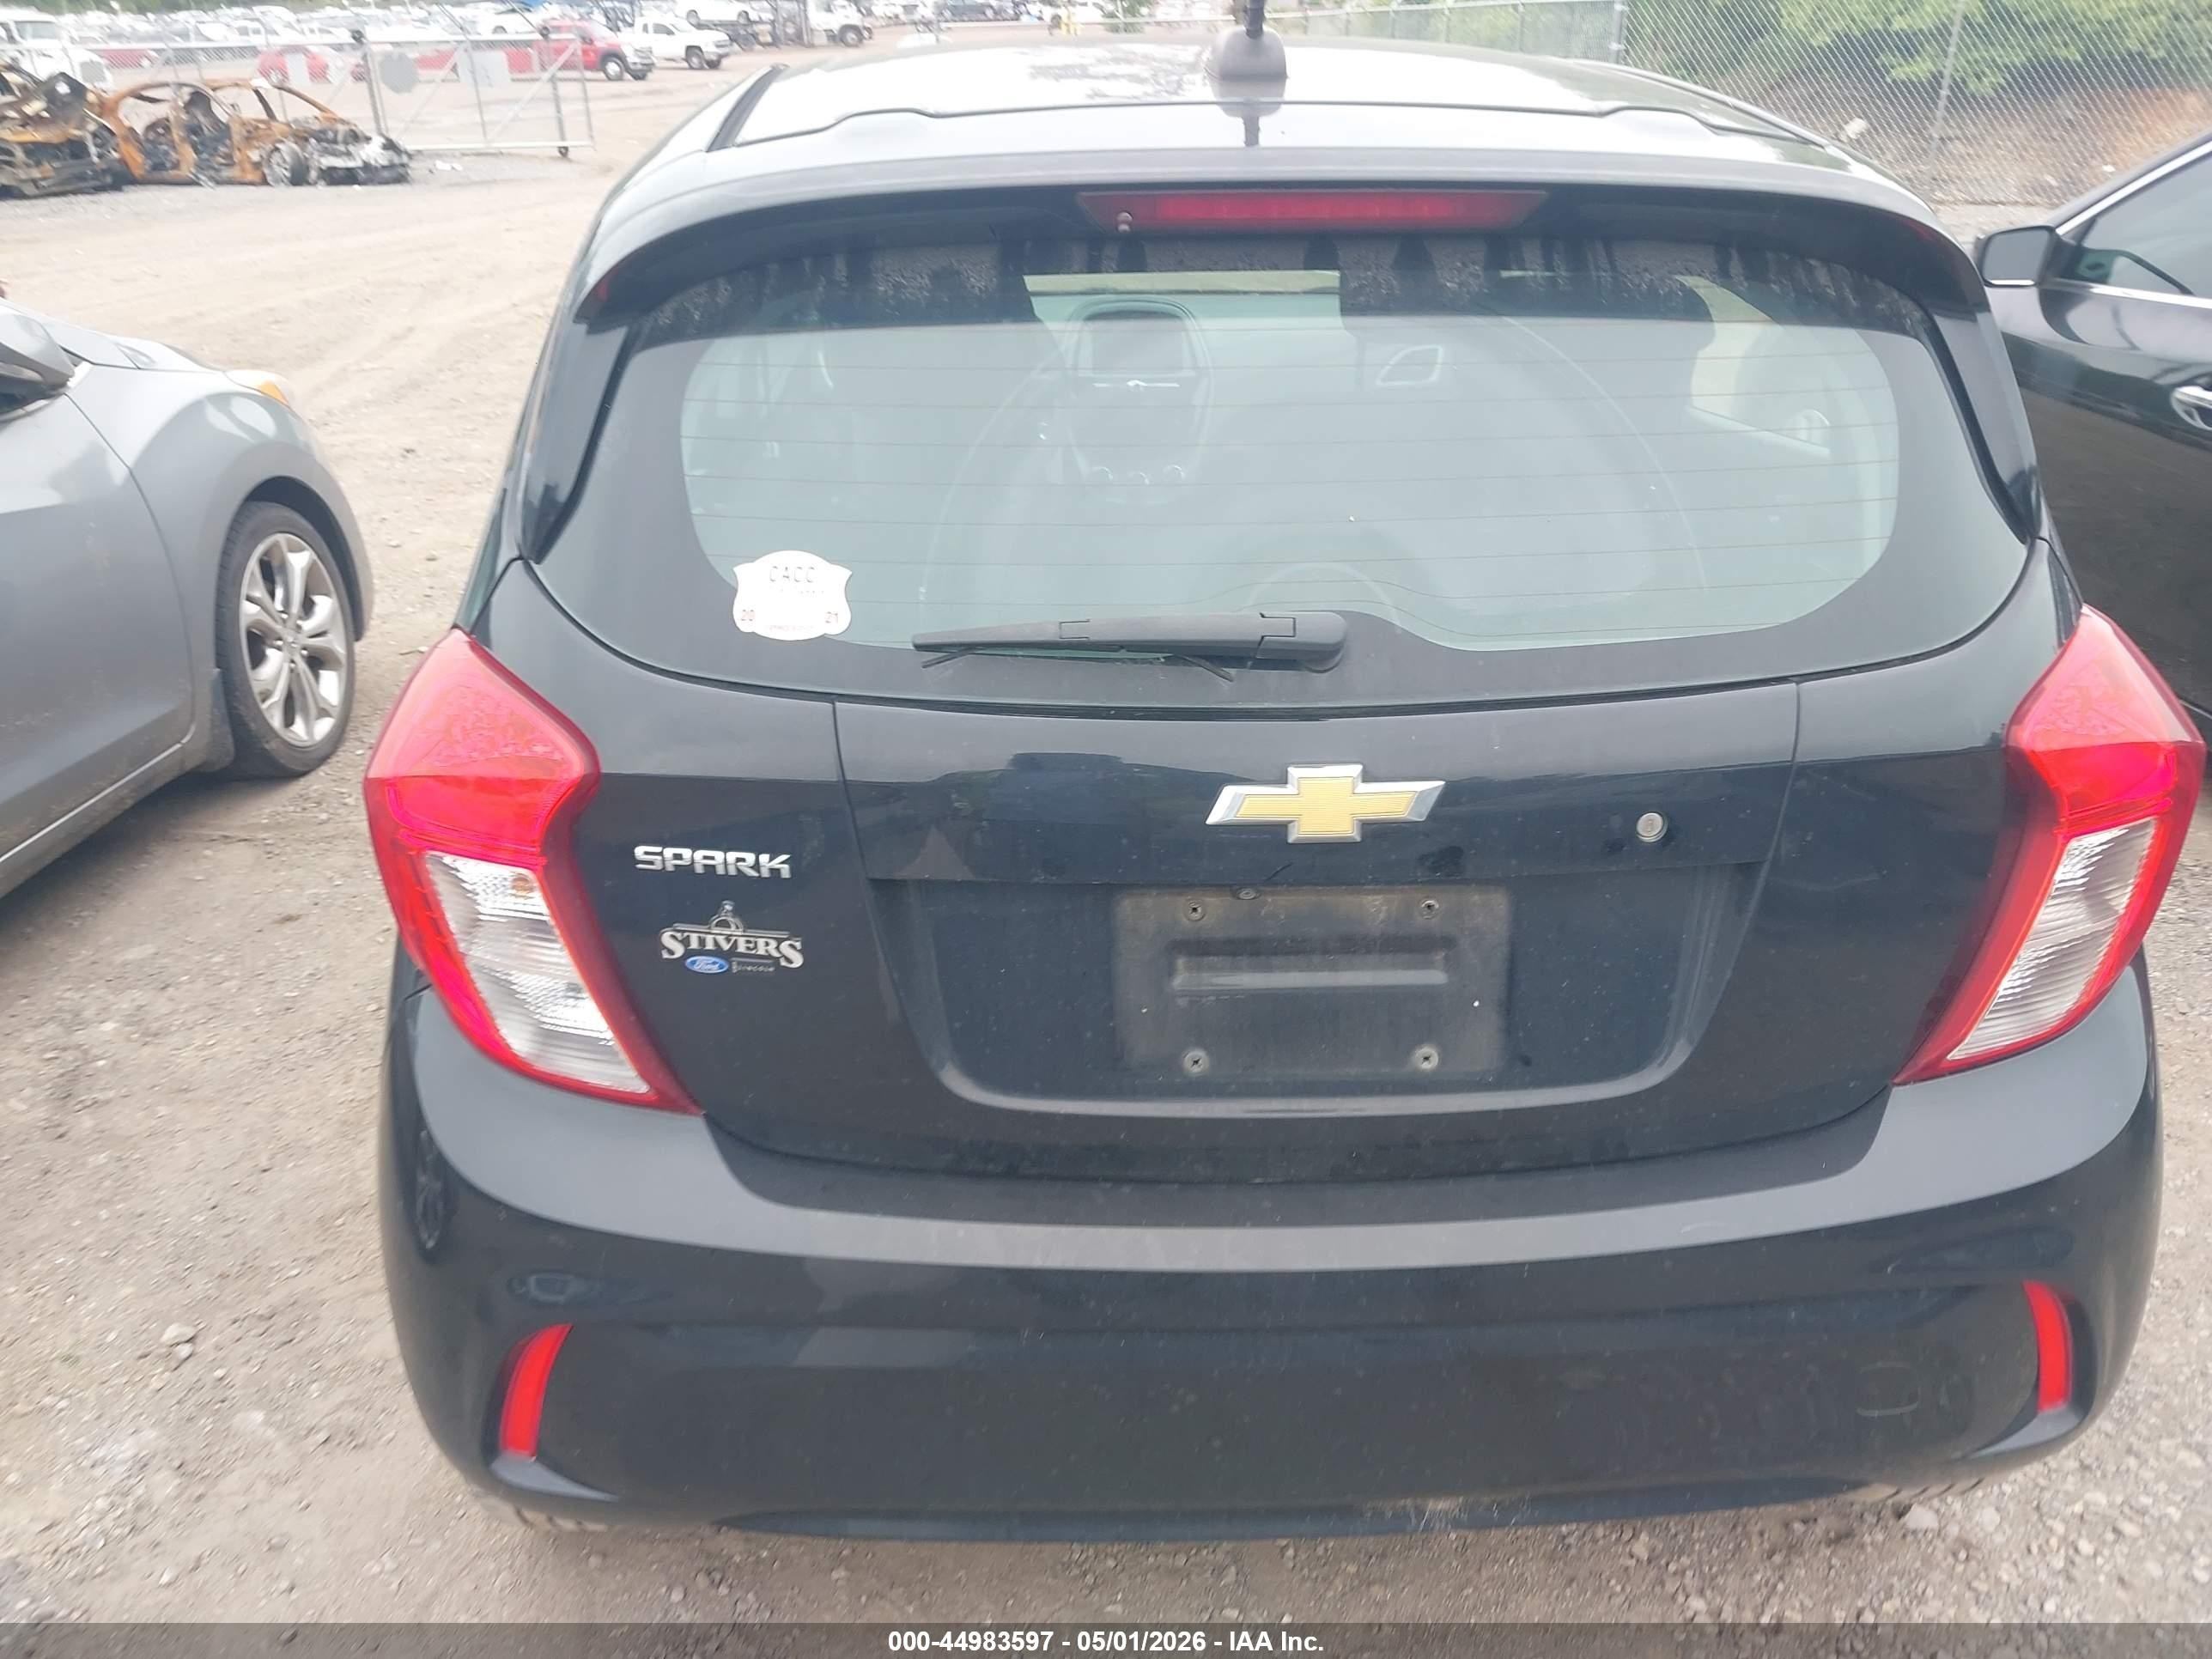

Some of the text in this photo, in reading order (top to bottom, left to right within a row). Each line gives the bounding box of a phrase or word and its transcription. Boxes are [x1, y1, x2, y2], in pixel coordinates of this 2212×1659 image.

[634, 845, 792, 878] SPARK
[659, 930, 805, 969] STIVERS
[689, 957, 724, 972] Ford
